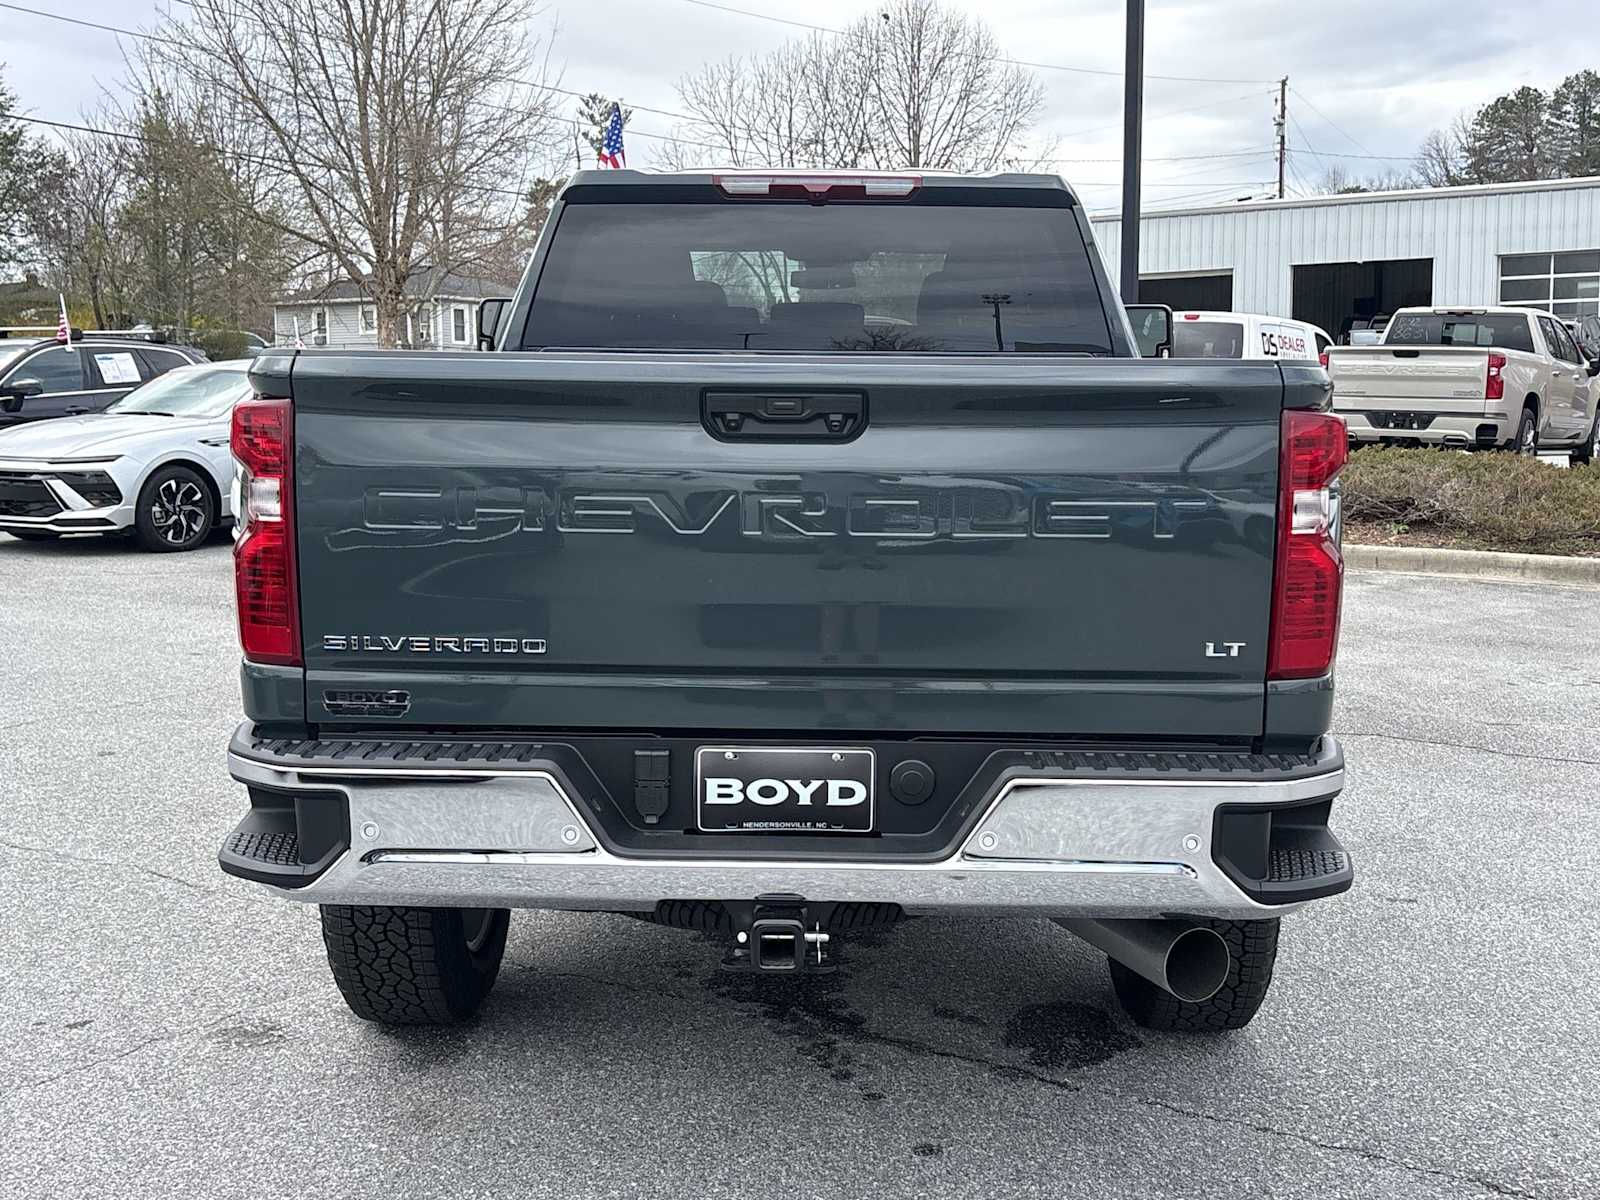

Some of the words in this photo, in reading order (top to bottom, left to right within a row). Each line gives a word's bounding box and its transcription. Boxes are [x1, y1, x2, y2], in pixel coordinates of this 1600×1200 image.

[1261, 332, 1278, 356] DS
[1278, 335, 1306, 352] DEALER
[363, 486, 1210, 540] CHEVROLET
[322, 634, 548, 654] SILVERADO
[1205, 642, 1247, 657] LT
[704, 777, 868, 806] BOYD
